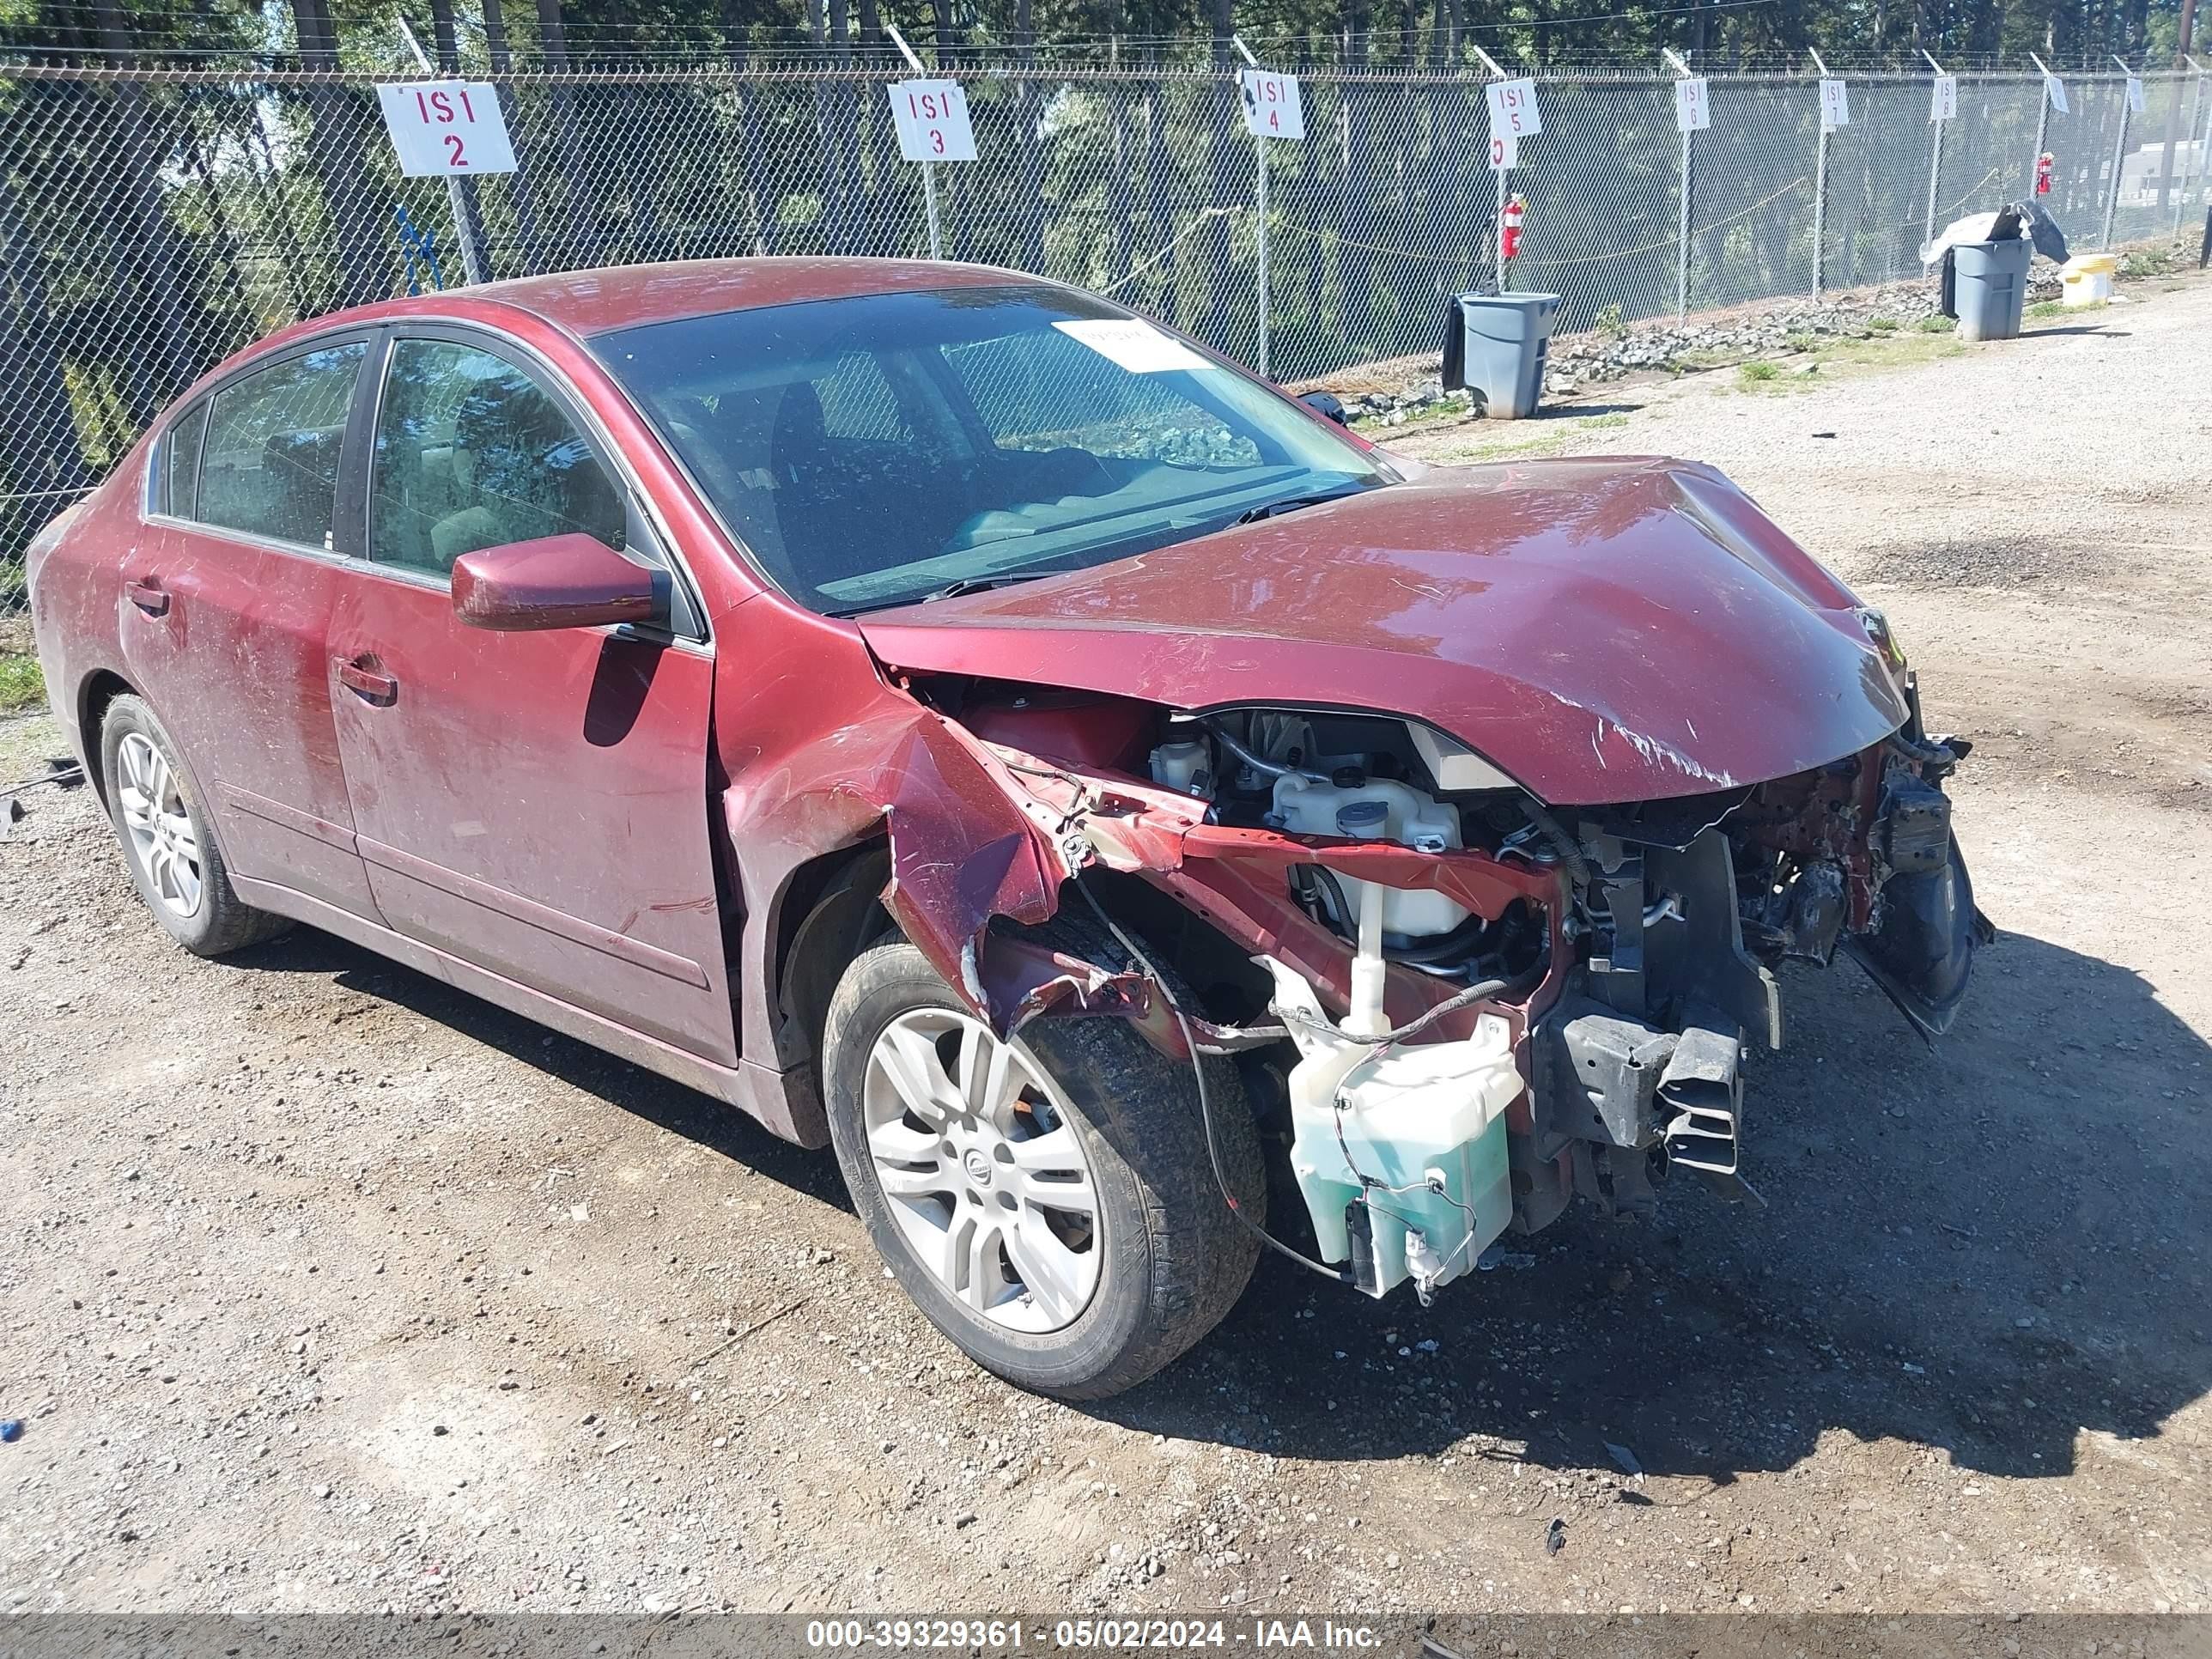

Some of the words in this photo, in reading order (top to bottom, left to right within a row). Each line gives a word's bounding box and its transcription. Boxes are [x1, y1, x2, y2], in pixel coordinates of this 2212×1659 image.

[1832, 106, 1838, 123] 7
[1943, 101, 1950, 115] 8
[1269, 109, 1279, 131] 4
[1510, 112, 1522, 132] 5
[443, 135, 469, 166] 2
[929, 129, 945, 155] 3
